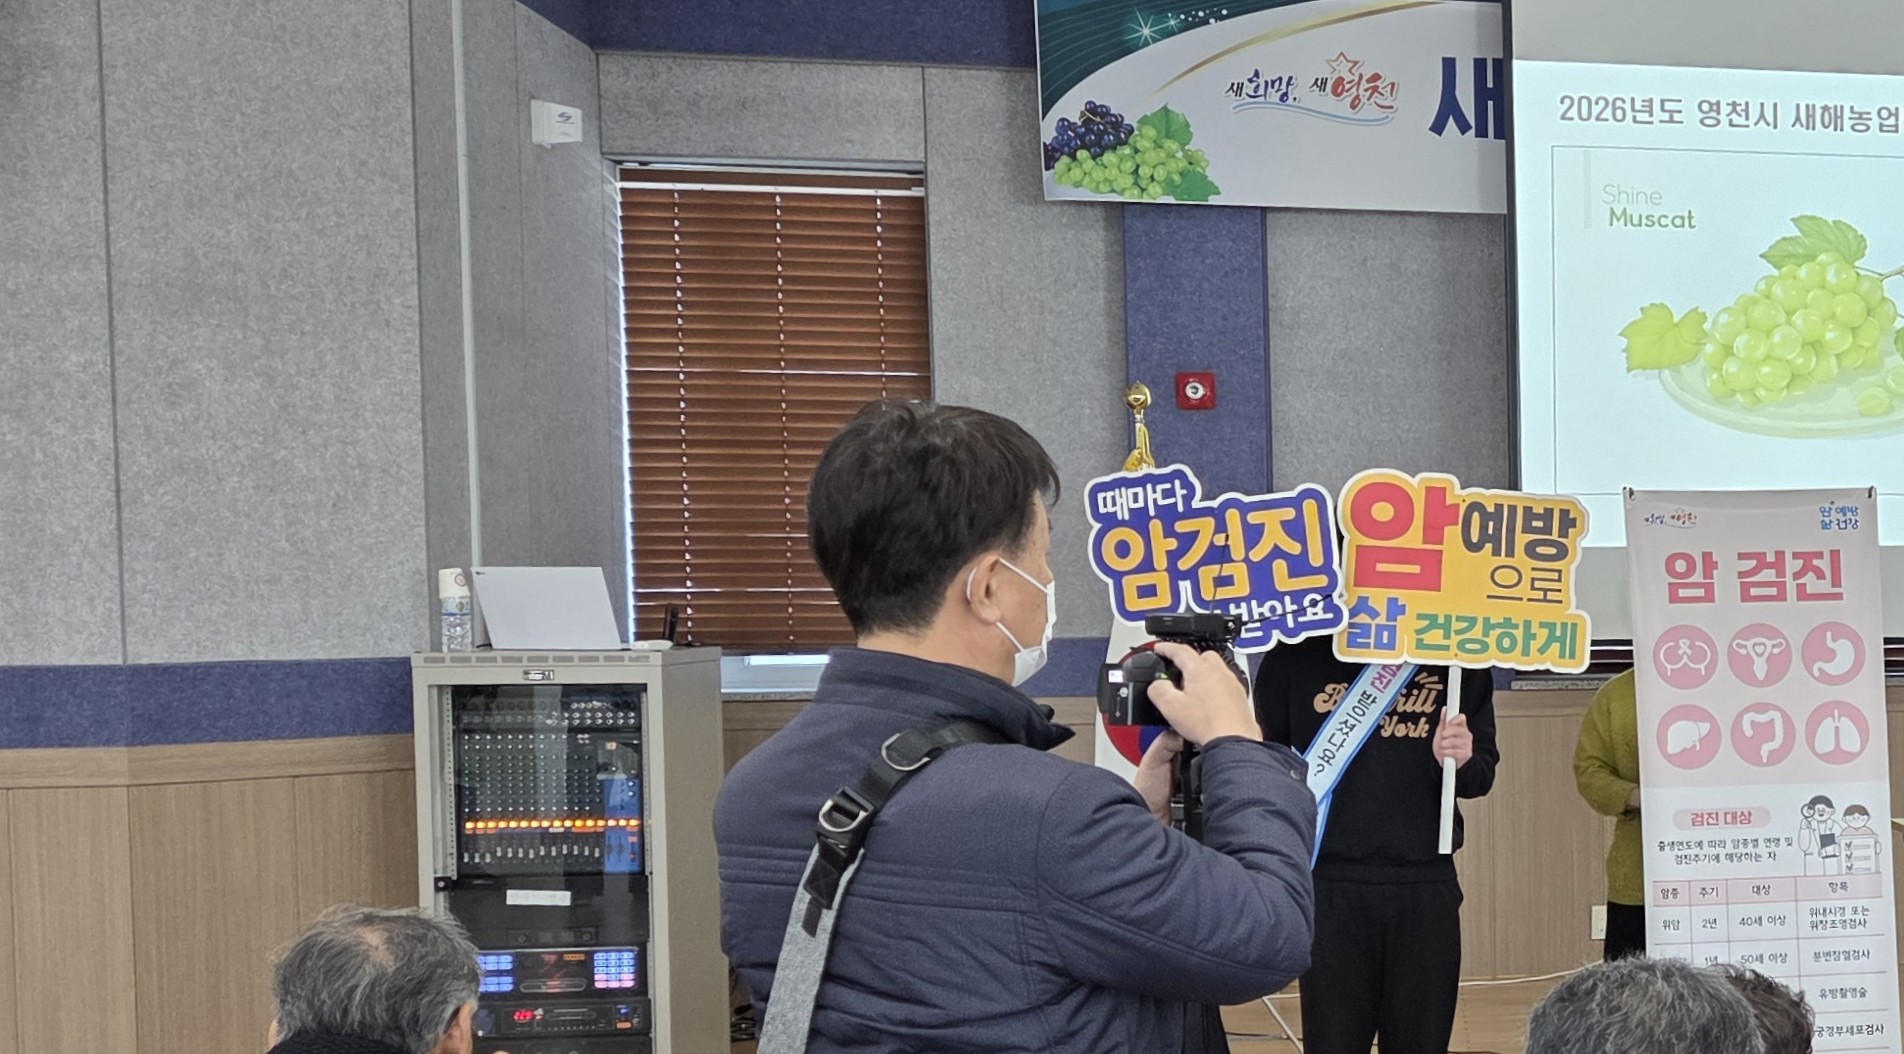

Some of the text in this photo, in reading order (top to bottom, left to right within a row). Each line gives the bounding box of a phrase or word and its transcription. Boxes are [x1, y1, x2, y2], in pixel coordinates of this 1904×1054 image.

[1225, 81, 1245, 98] 새
[1309, 77, 1328, 93] 새
[1331, 72, 1396, 110] 영천
[1559, 94, 1685, 126] 2026년도
[1697, 99, 1779, 130] 영천시
[1602, 183, 1663, 206] Shine
[1609, 207, 1697, 229] Muscat
[1097, 479, 1187, 520] 때마다
[1350, 481, 1460, 592] 암
[1461, 500, 1577, 562] 예방
[1101, 498, 1329, 612] 암검진
[1486, 564, 1563, 604] 으로
[1664, 549, 1844, 604] 암 검진
[1229, 592, 1334, 639] 받아요
[1346, 596, 1578, 660] 삶 건강하게
[1313, 689, 1378, 777] 받으셨나요?
[1379, 715, 1431, 739] York
[1690, 809, 1753, 827] 검진 대상
[1707, 839, 1727, 850] 따라
[1730, 838, 1759, 850] 암종별
[1763, 837, 1781, 849] 연령
[1784, 836, 1794, 847] 및
[1674, 851, 1777, 865] 검진주기에 해당하는 자
[1699, 886, 1719, 898] 주기
[1751, 884, 1771, 896] 대상
[1828, 881, 1849, 893] 항목
[1661, 914, 1786, 931] 위암 2년 40세 이상
[1808, 905, 1870, 918] 위내시경 또는
[1808, 917, 1868, 931] 위장조영검사
[1740, 952, 1764, 964] 50세
[1768, 951, 1788, 964] 이상
[1813, 1023, 1885, 1038] 궁경부세포검사
